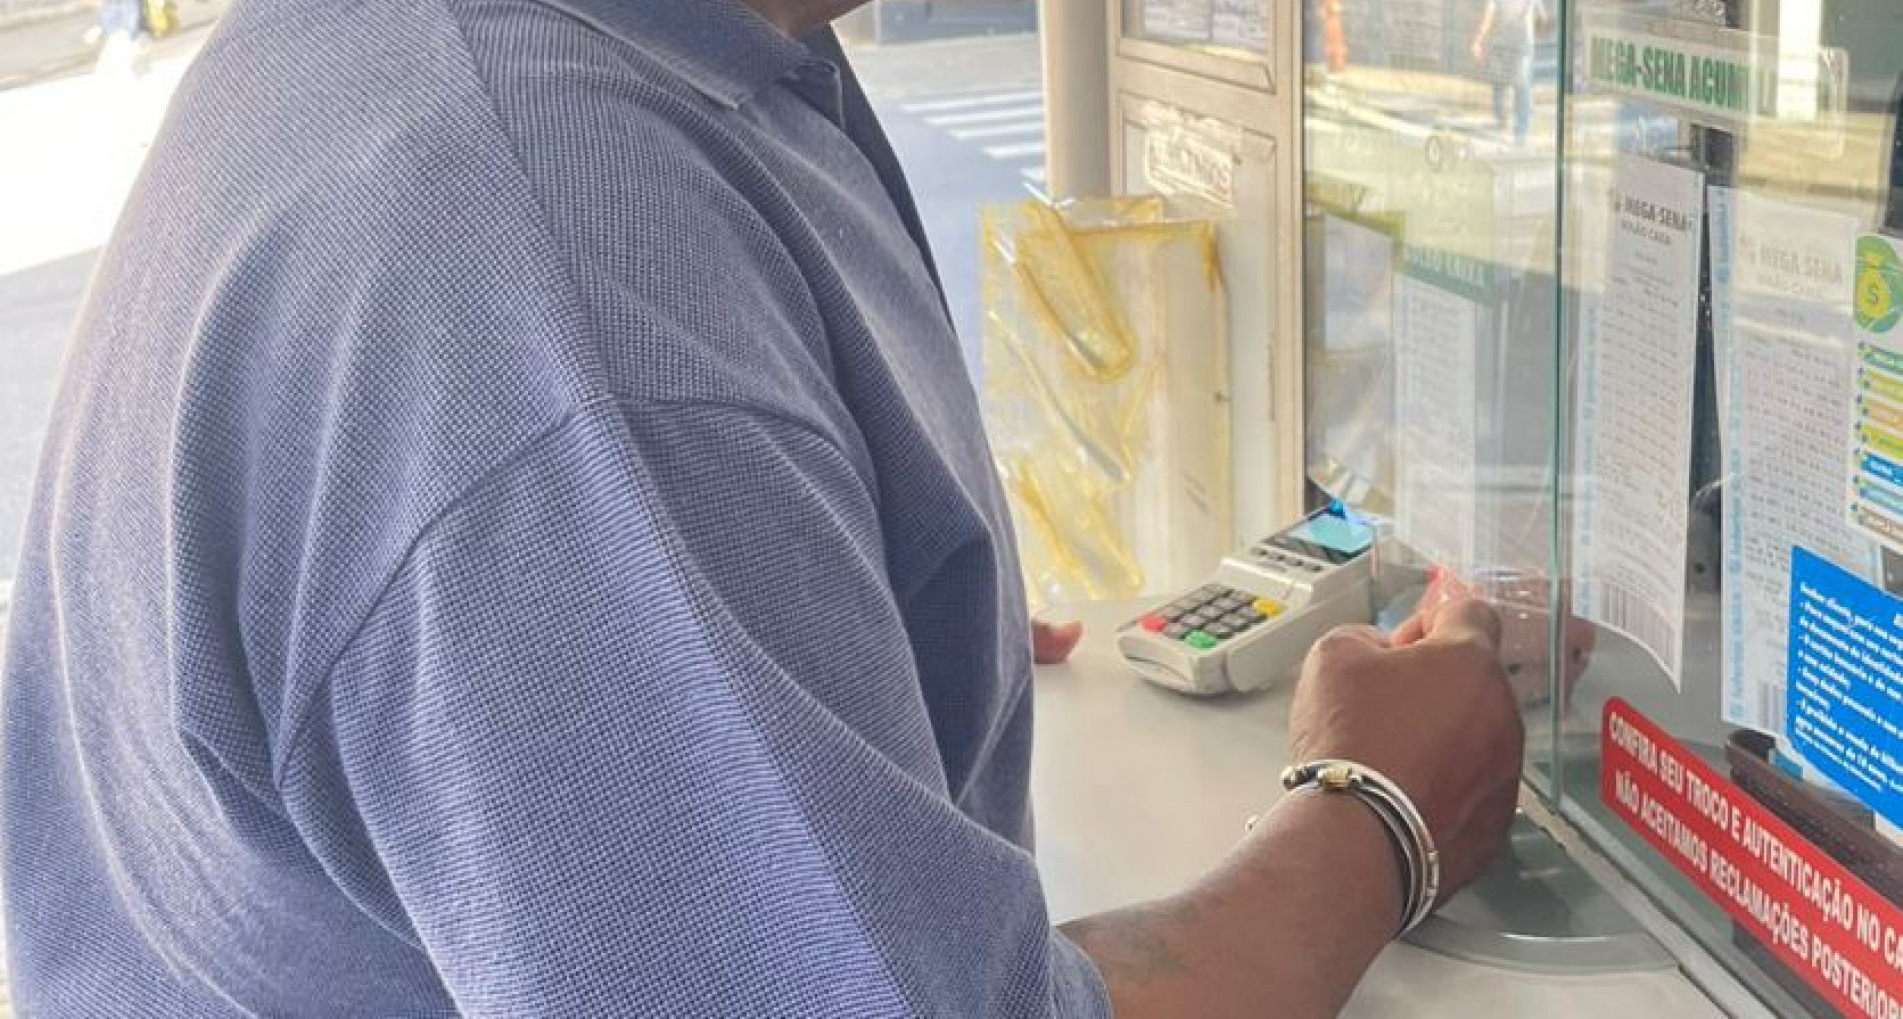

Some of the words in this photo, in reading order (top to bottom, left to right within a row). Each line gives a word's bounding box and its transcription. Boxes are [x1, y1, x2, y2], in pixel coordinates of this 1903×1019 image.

[1608, 711, 1658, 776] CONFIRA
[1659, 749, 1685, 795] SEU
[1686, 769, 1729, 832] TROCO
[1731, 805, 1741, 842] E
[1742, 815, 1854, 931] AUTENTICAÇÃO
[1856, 903, 1881, 952] NO
[1615, 769, 1640, 815] NÃO
[1640, 791, 1708, 873] ACEITAMOS
[1709, 848, 1808, 961] RECLAMAÇÕES
[1811, 934, 1903, 1019] POSTERIOR
